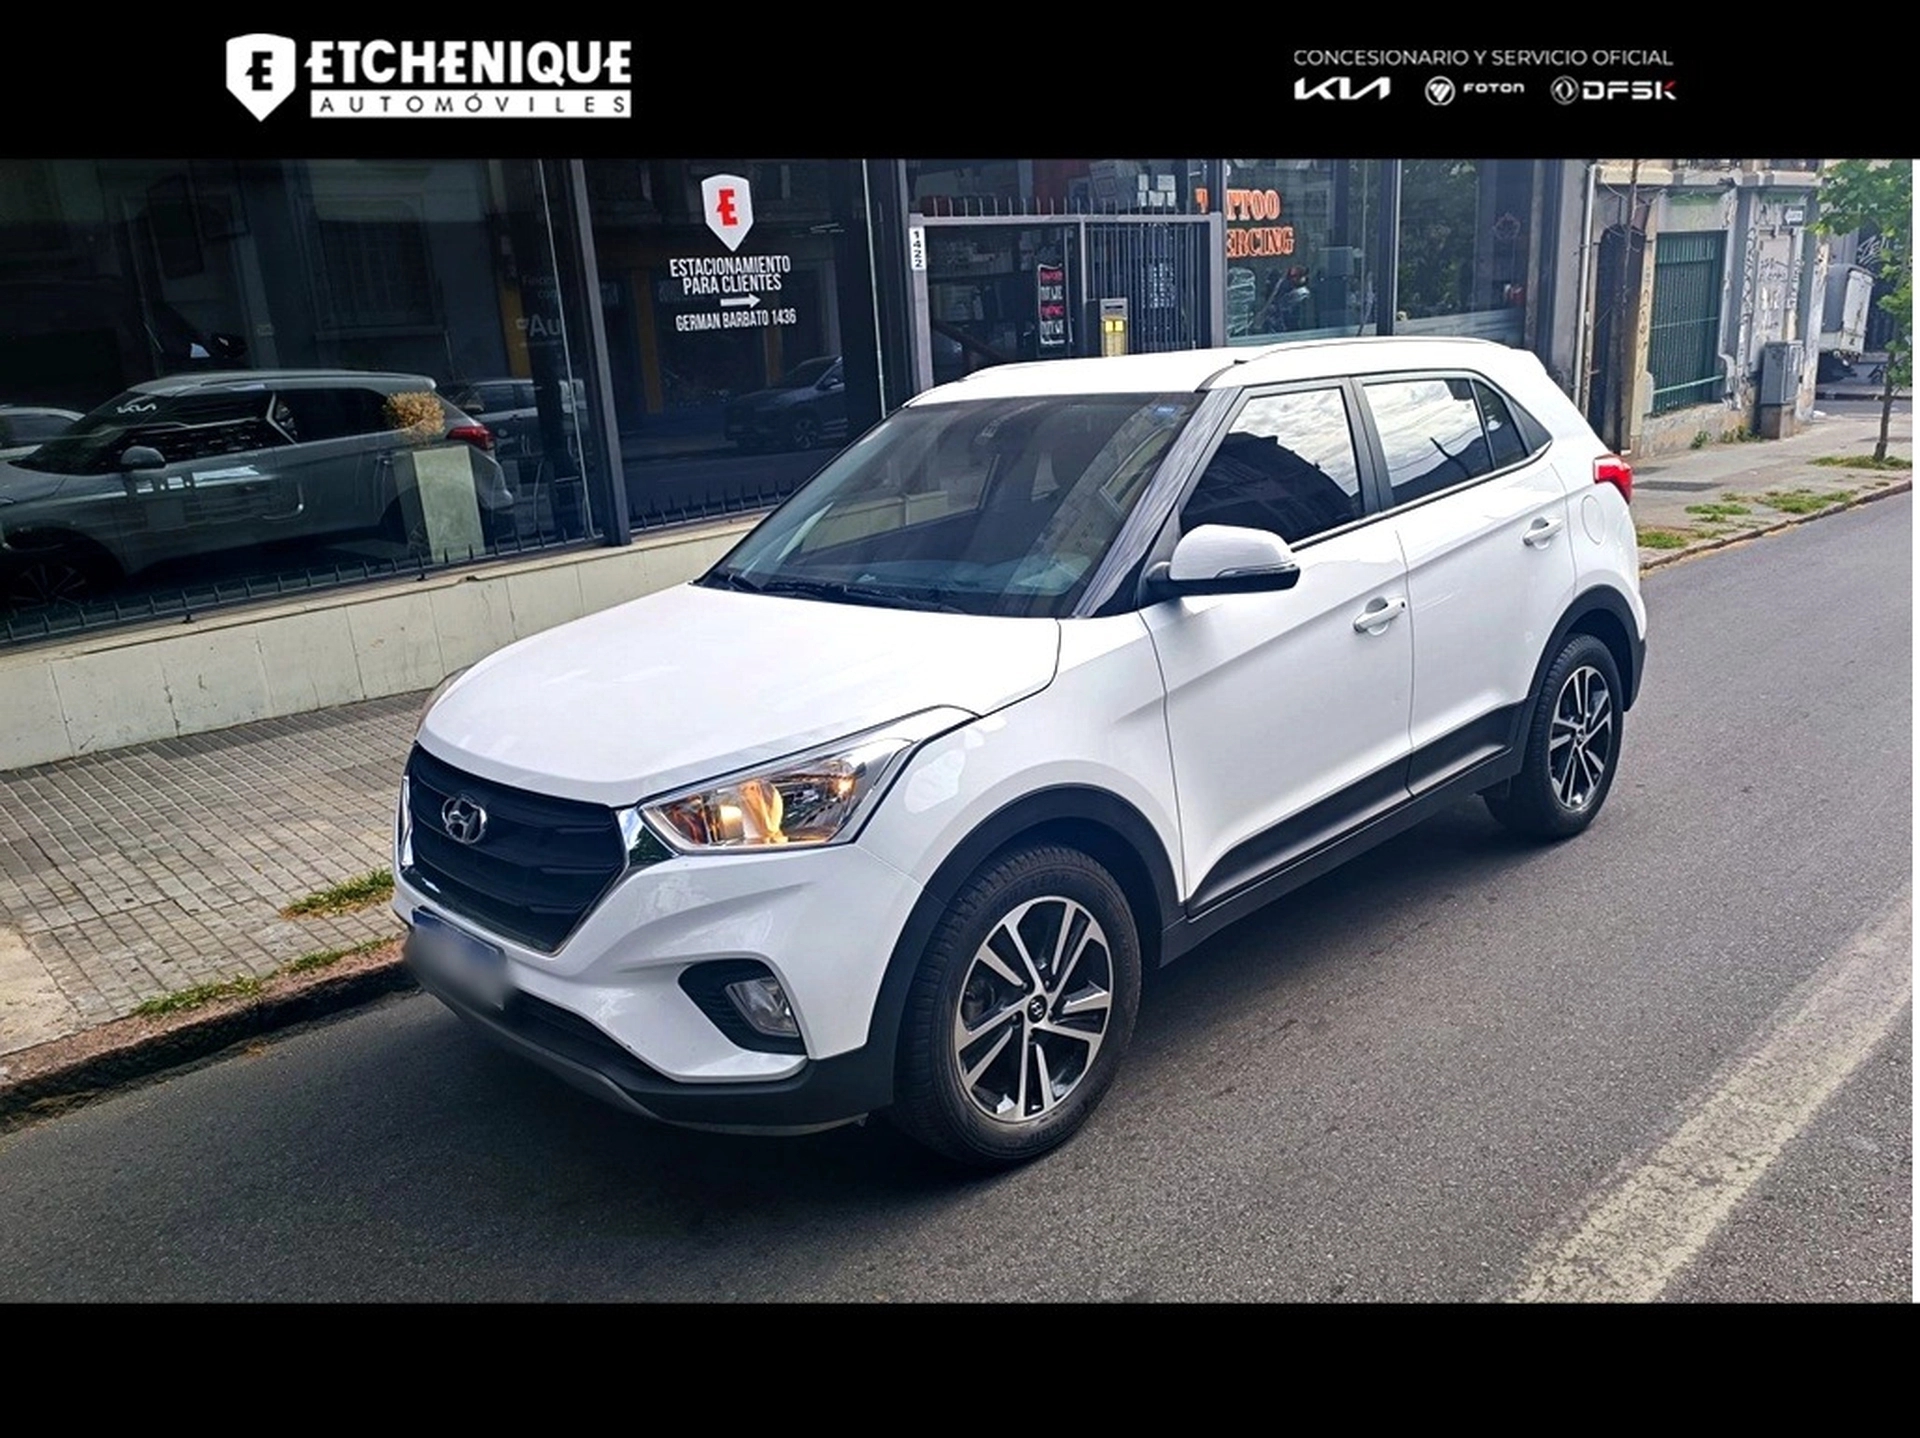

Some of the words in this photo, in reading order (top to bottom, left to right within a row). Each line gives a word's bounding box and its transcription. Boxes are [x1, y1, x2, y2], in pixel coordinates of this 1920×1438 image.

[1195, 188, 1281, 221] TTTOO
[1226, 225, 1294, 257] ERCING
[669, 255, 792, 278] ESTACIONAMIENTO
[682, 276, 720, 296] PARA
[721, 273, 782, 293] CLIENTES
[675, 312, 721, 332] GERMAN
[722, 309, 769, 329] BARBATO
[771, 308, 797, 325] 1436
